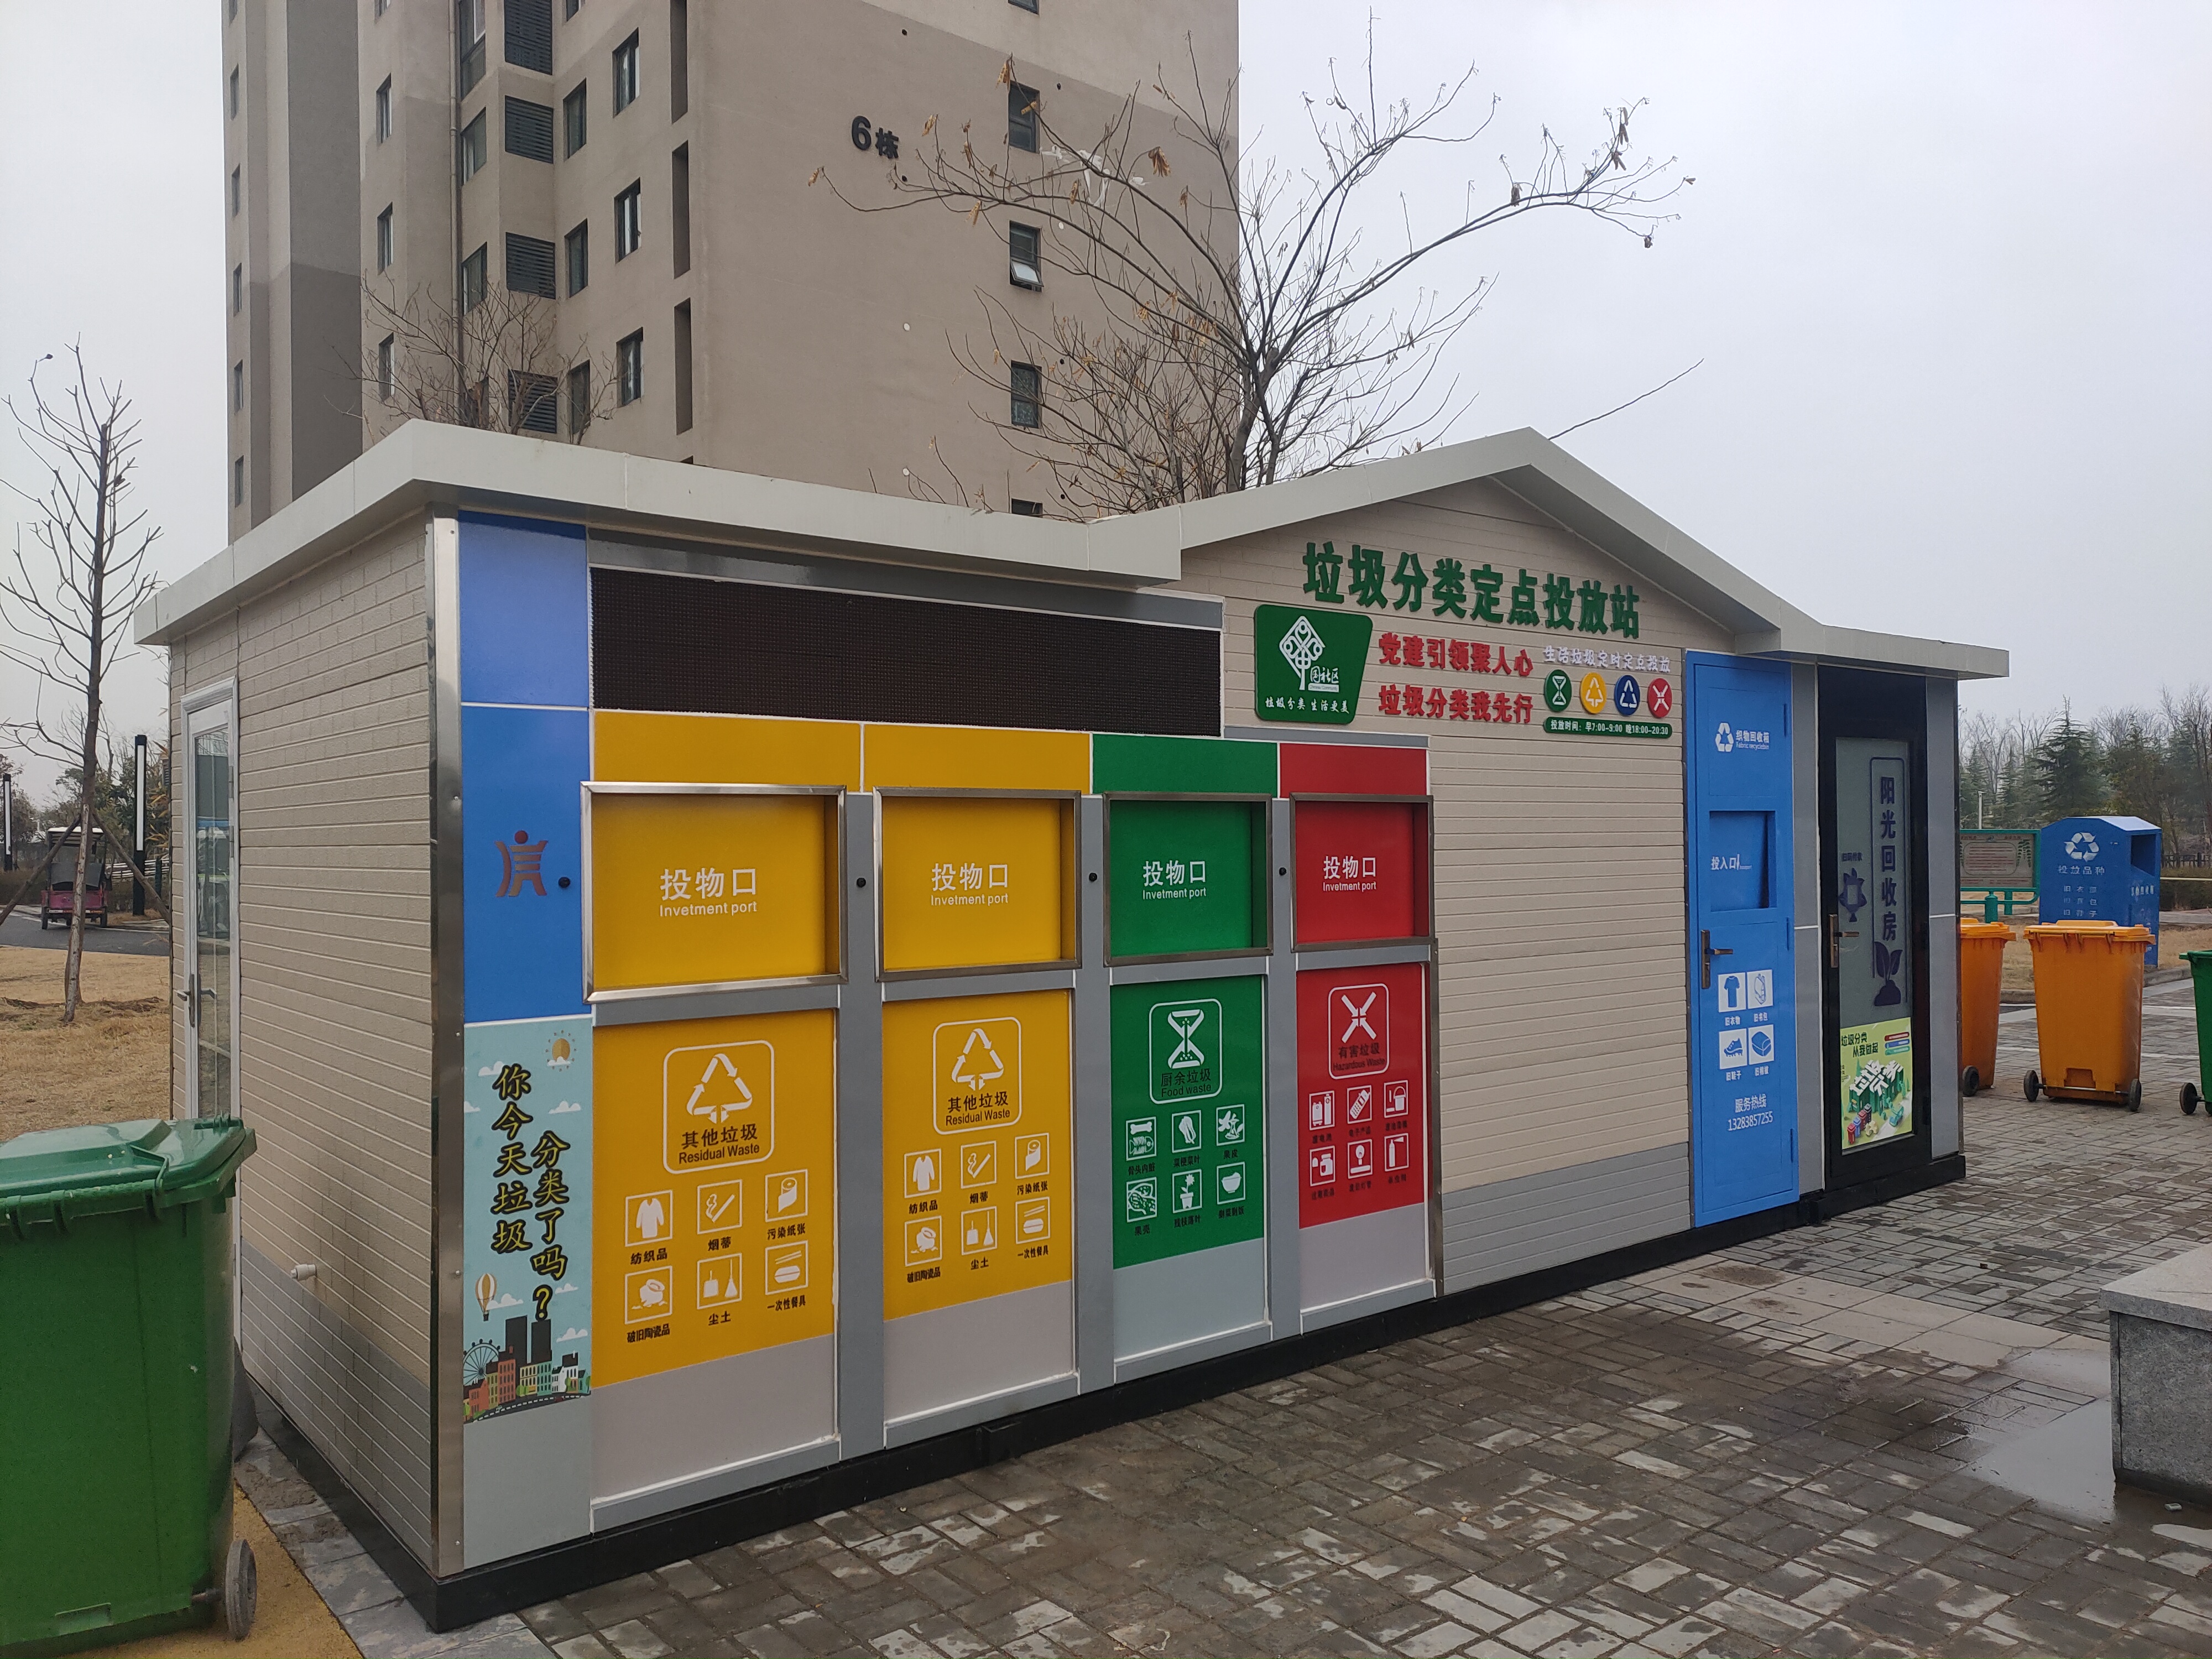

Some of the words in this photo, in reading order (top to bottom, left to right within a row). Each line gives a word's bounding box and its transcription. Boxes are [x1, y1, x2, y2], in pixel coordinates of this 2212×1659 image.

[852, 116, 899, 159] 6栋
[1303, 541, 1640, 639] 垃圾分类定点投放站
[1379, 632, 1533, 676] 党建引领聚人心
[1543, 645, 1671, 673] 生活垃圾定时定点投放
[1265, 696, 1305, 710] 垃圾分类
[1311, 698, 1349, 714] 生活更美
[1379, 684, 1533, 724] 垃圾分类我先行
[1736, 729, 1770, 743] 织物回收箱
[1323, 855, 1376, 879] 投物口
[1711, 856, 1736, 870] 投入口
[1880, 776, 1897, 941] 阳光回收房
[931, 863, 1008, 891] 投物口
[1142, 860, 1206, 886] 投物口
[660, 867, 756, 901] 投物口
[1323, 881, 1360, 891] Invetment
[1361, 881, 1376, 893] port
[931, 894, 985, 906] Invetment
[988, 893, 1008, 906] port
[1142, 888, 1187, 900] Invetment
[1189, 887, 1207, 899] port
[660, 902, 728, 917] Invetment
[731, 901, 757, 916] port
[1841, 1032, 1867, 1046] 垃圾分类
[1853, 1042, 1879, 1057] 从我做起
[1161, 1068, 1211, 1087] 厨余垃圾
[1161, 1086, 1183, 1097] Food
[1186, 1084, 1211, 1094] waste
[948, 1091, 1008, 1113] 其他垃圾
[1735, 1093, 1767, 1113] 服务热线
[946, 1110, 982, 1126] Residual
[984, 1108, 1010, 1120] Waste
[1728, 1110, 1773, 1131] 13283857255
[681, 1124, 758, 1150] 其他垃圾
[492, 1063, 533, 1254] 你今天垃圾
[679, 1147, 724, 1164] Residual
[727, 1143, 760, 1157] Waste
[1017, 1181, 1048, 1195] 污染纸张
[909, 1199, 938, 1214] 纺织品
[969, 1191, 988, 1204] 烟蒂
[767, 1223, 806, 1240] 污染纸张
[708, 1237, 732, 1251] 烟蒂
[630, 1248, 668, 1265] 纺织品
[971, 1257, 989, 1270] 尘土
[767, 1295, 806, 1311] 一次性餐具
[708, 1311, 731, 1326] 尘土
[627, 1323, 670, 1343] 破旧陶瓷品
